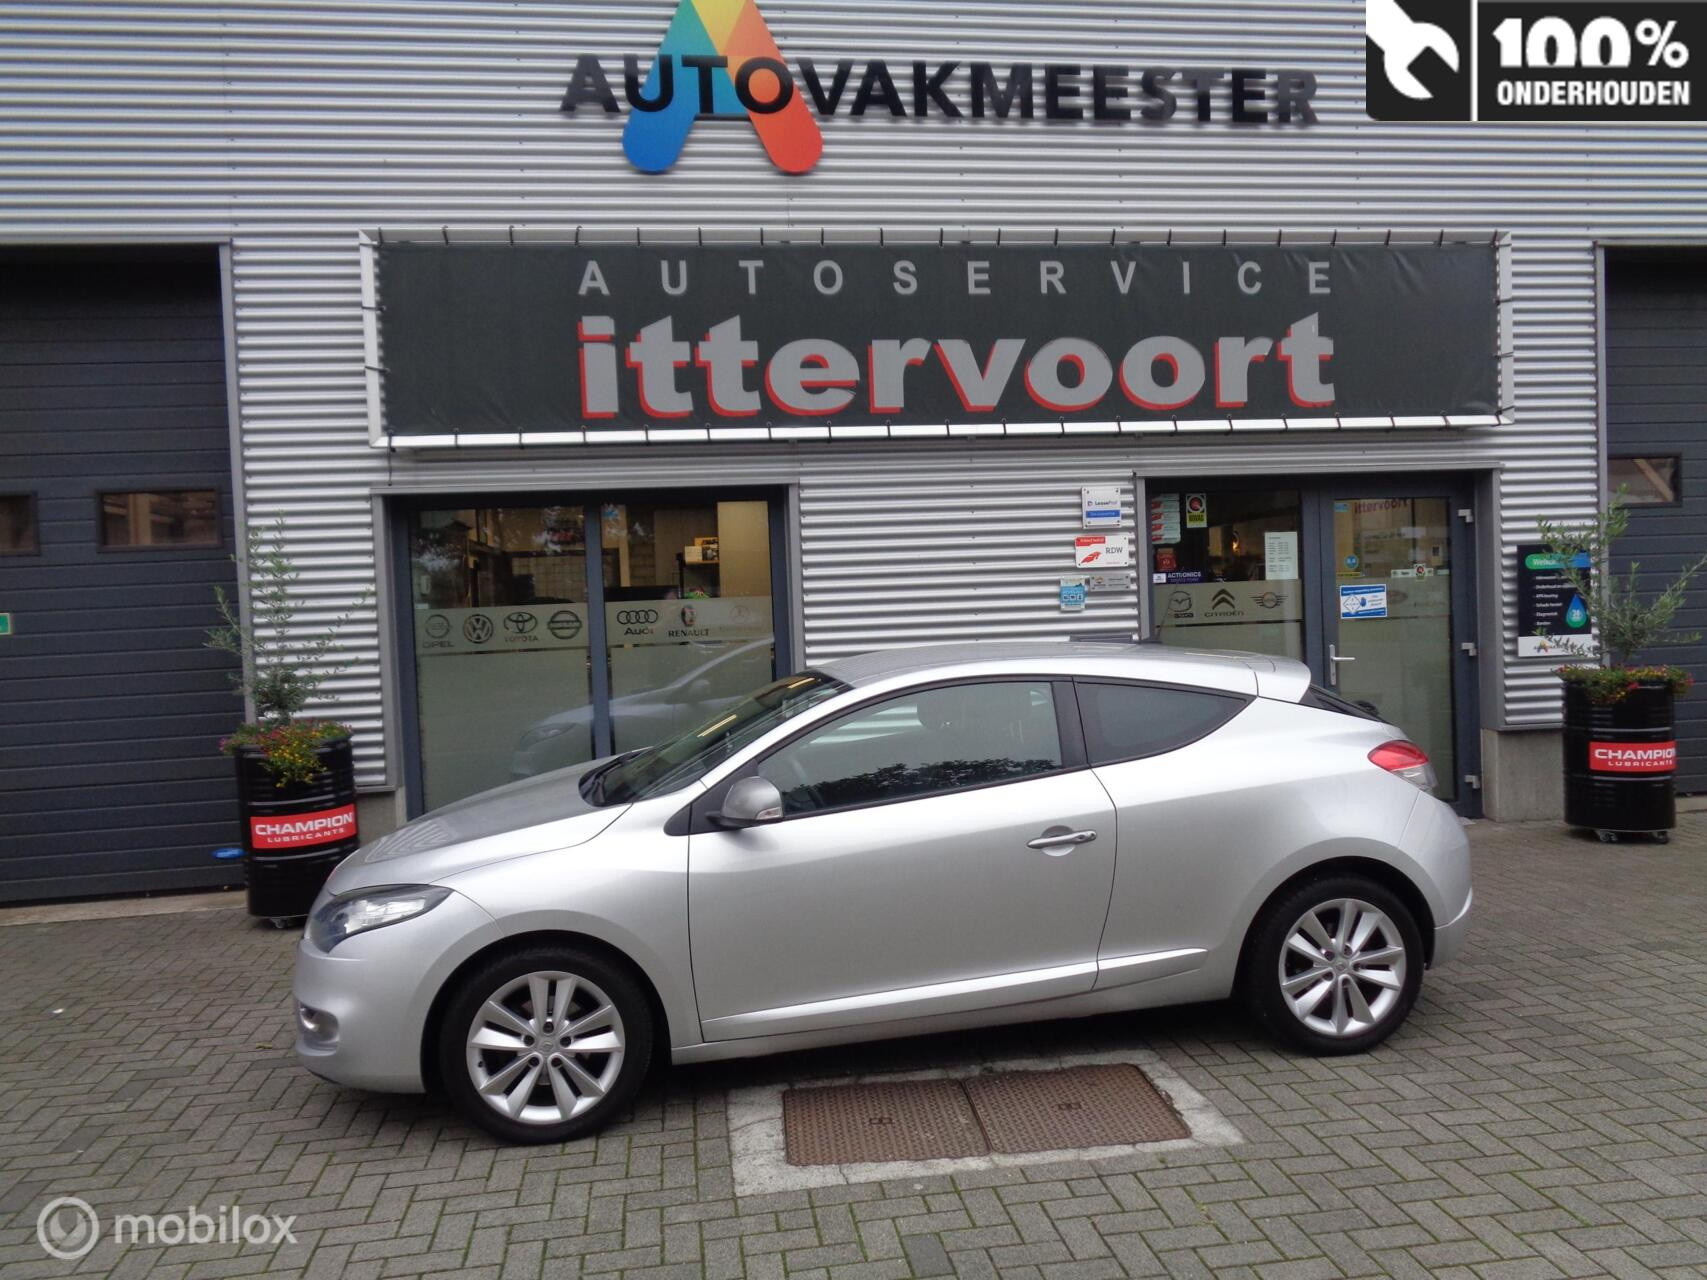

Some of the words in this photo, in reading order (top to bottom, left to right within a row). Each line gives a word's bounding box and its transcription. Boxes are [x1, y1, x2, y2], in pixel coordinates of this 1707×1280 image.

[560, 53, 1318, 124] AUTOVAKMEESTER
[577, 312, 1336, 419] ittervoort
[668, 628, 709, 638] RENAULT
[255, 812, 353, 836] CHAMPION
[267, 827, 344, 843] LUBRICANTS
